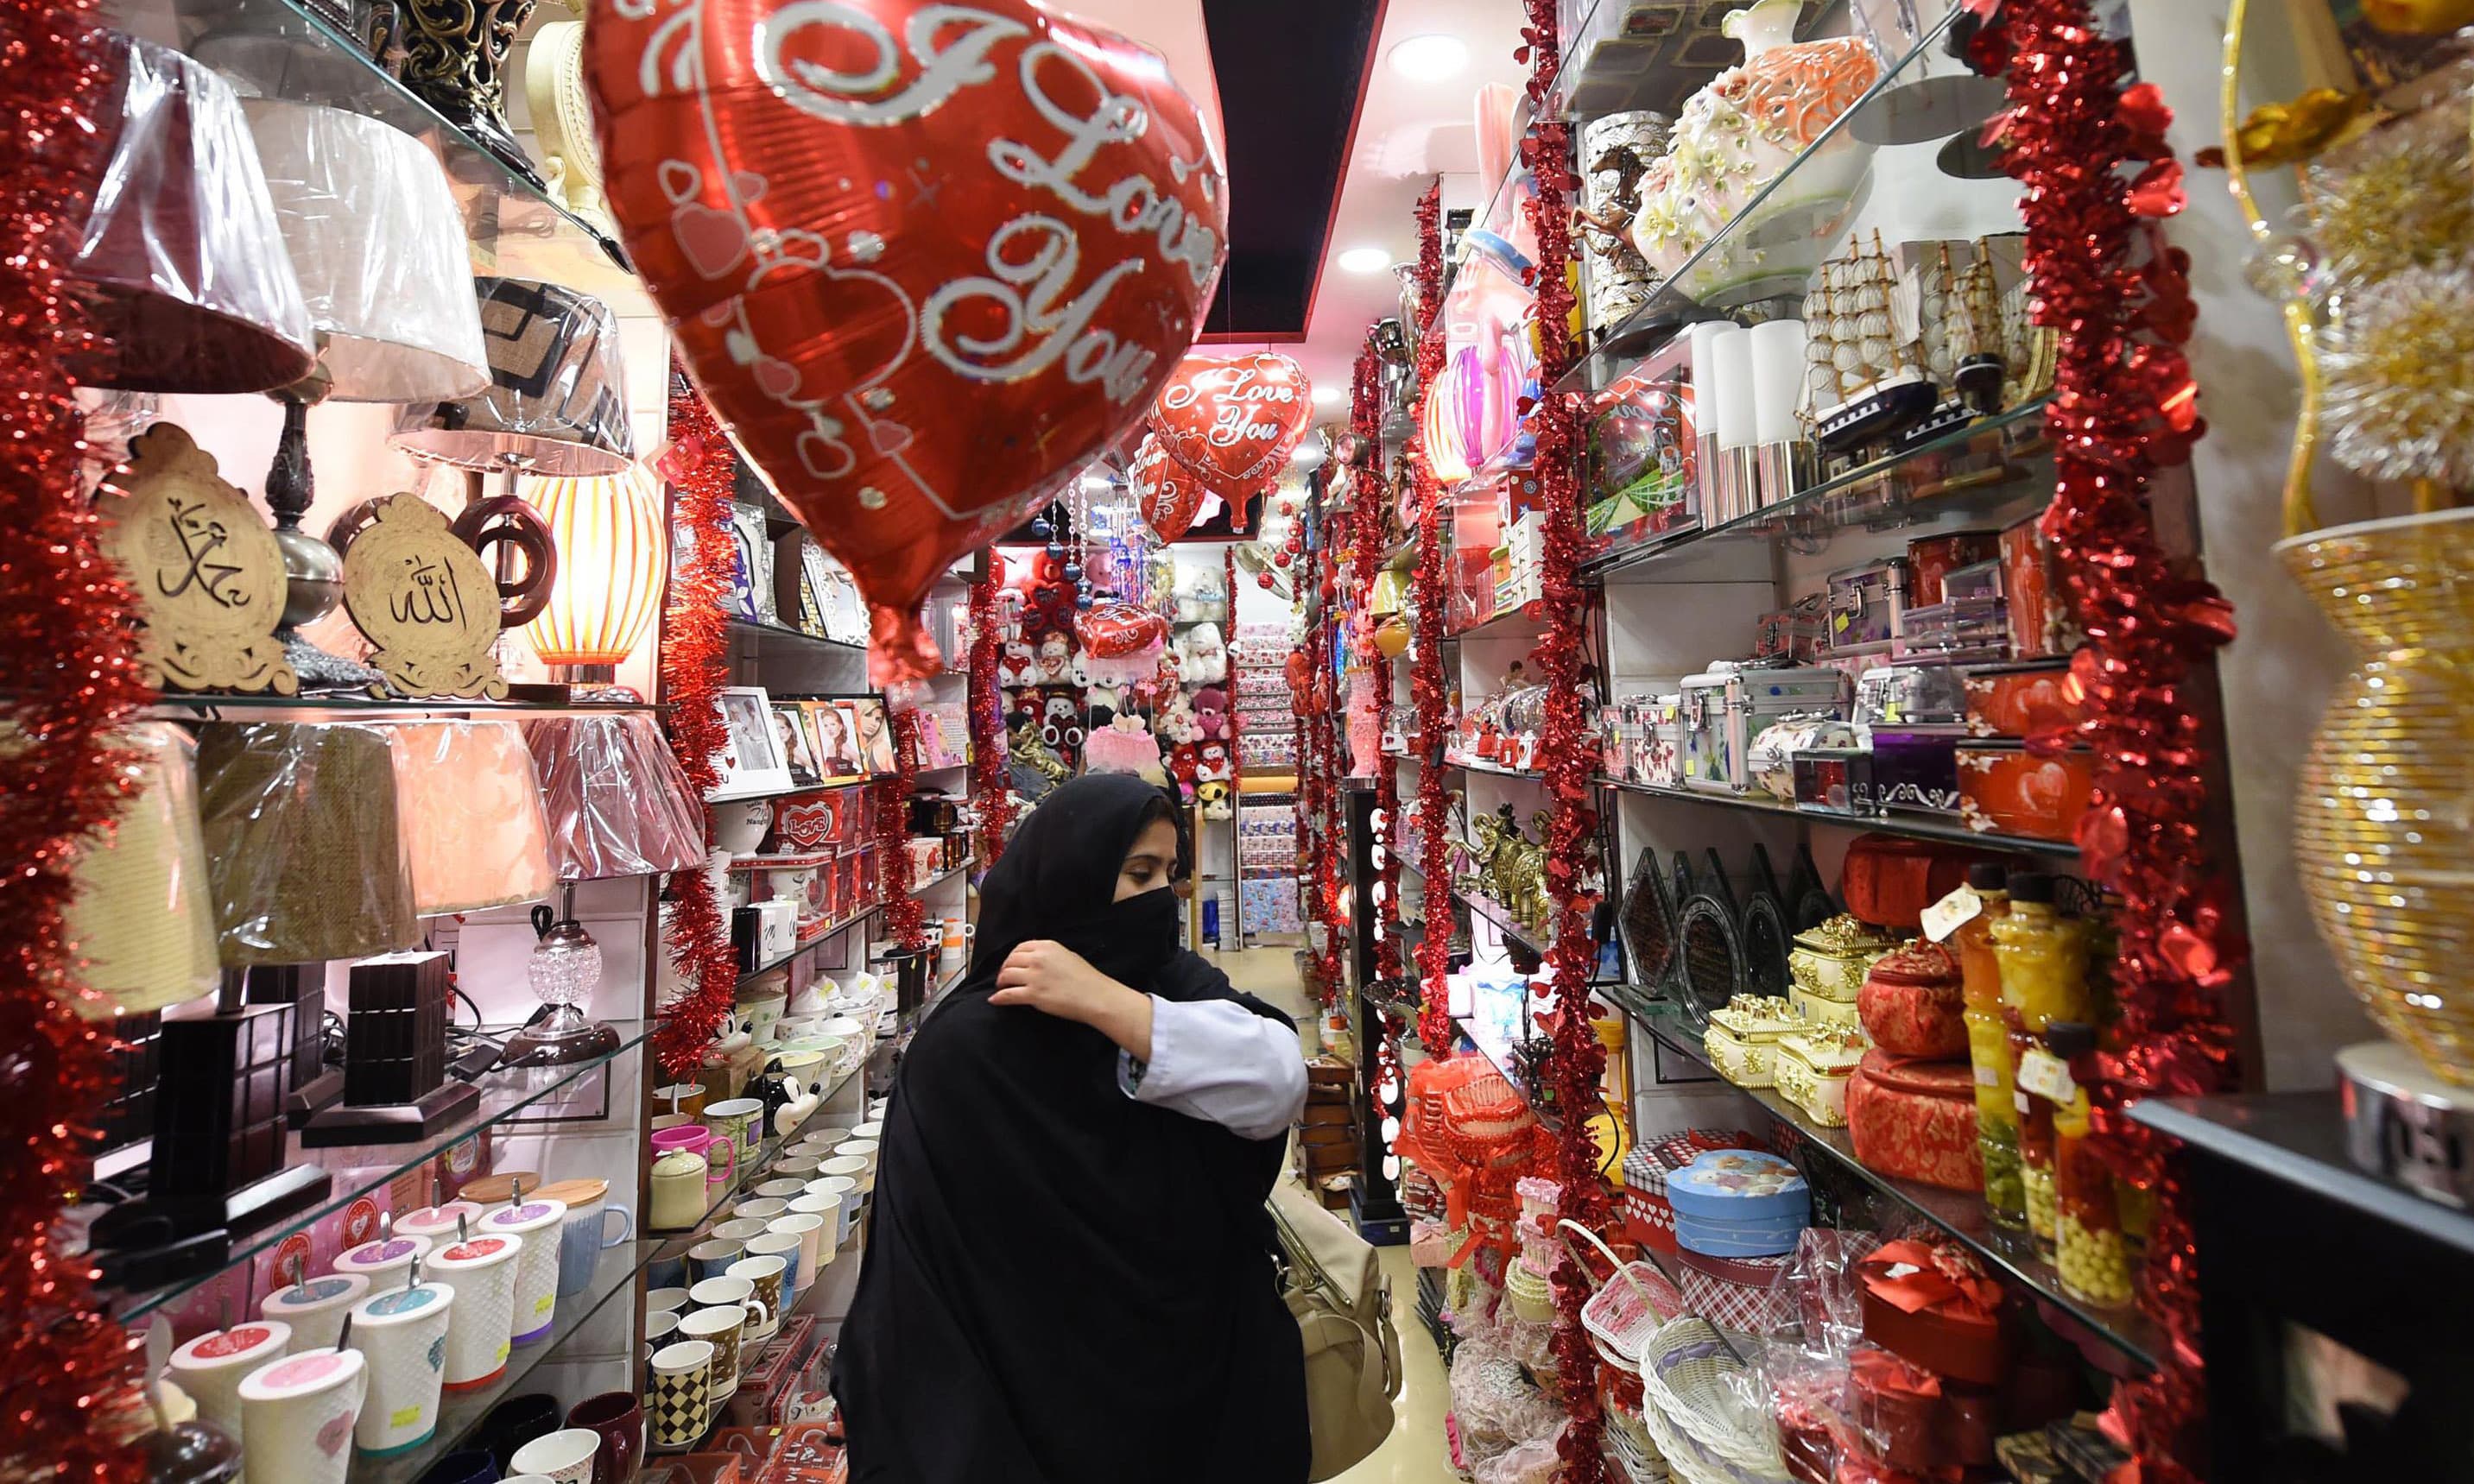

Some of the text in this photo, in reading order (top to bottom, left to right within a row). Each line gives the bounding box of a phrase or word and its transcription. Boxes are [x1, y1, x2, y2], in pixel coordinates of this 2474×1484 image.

[753, 0, 1031, 126] I
[986, 41, 1218, 286] Love
[921, 215, 1158, 405] You
[1208, 403, 1279, 447] You
[1212, 367, 1294, 401] Love
[789, 815, 827, 837] LOVE
